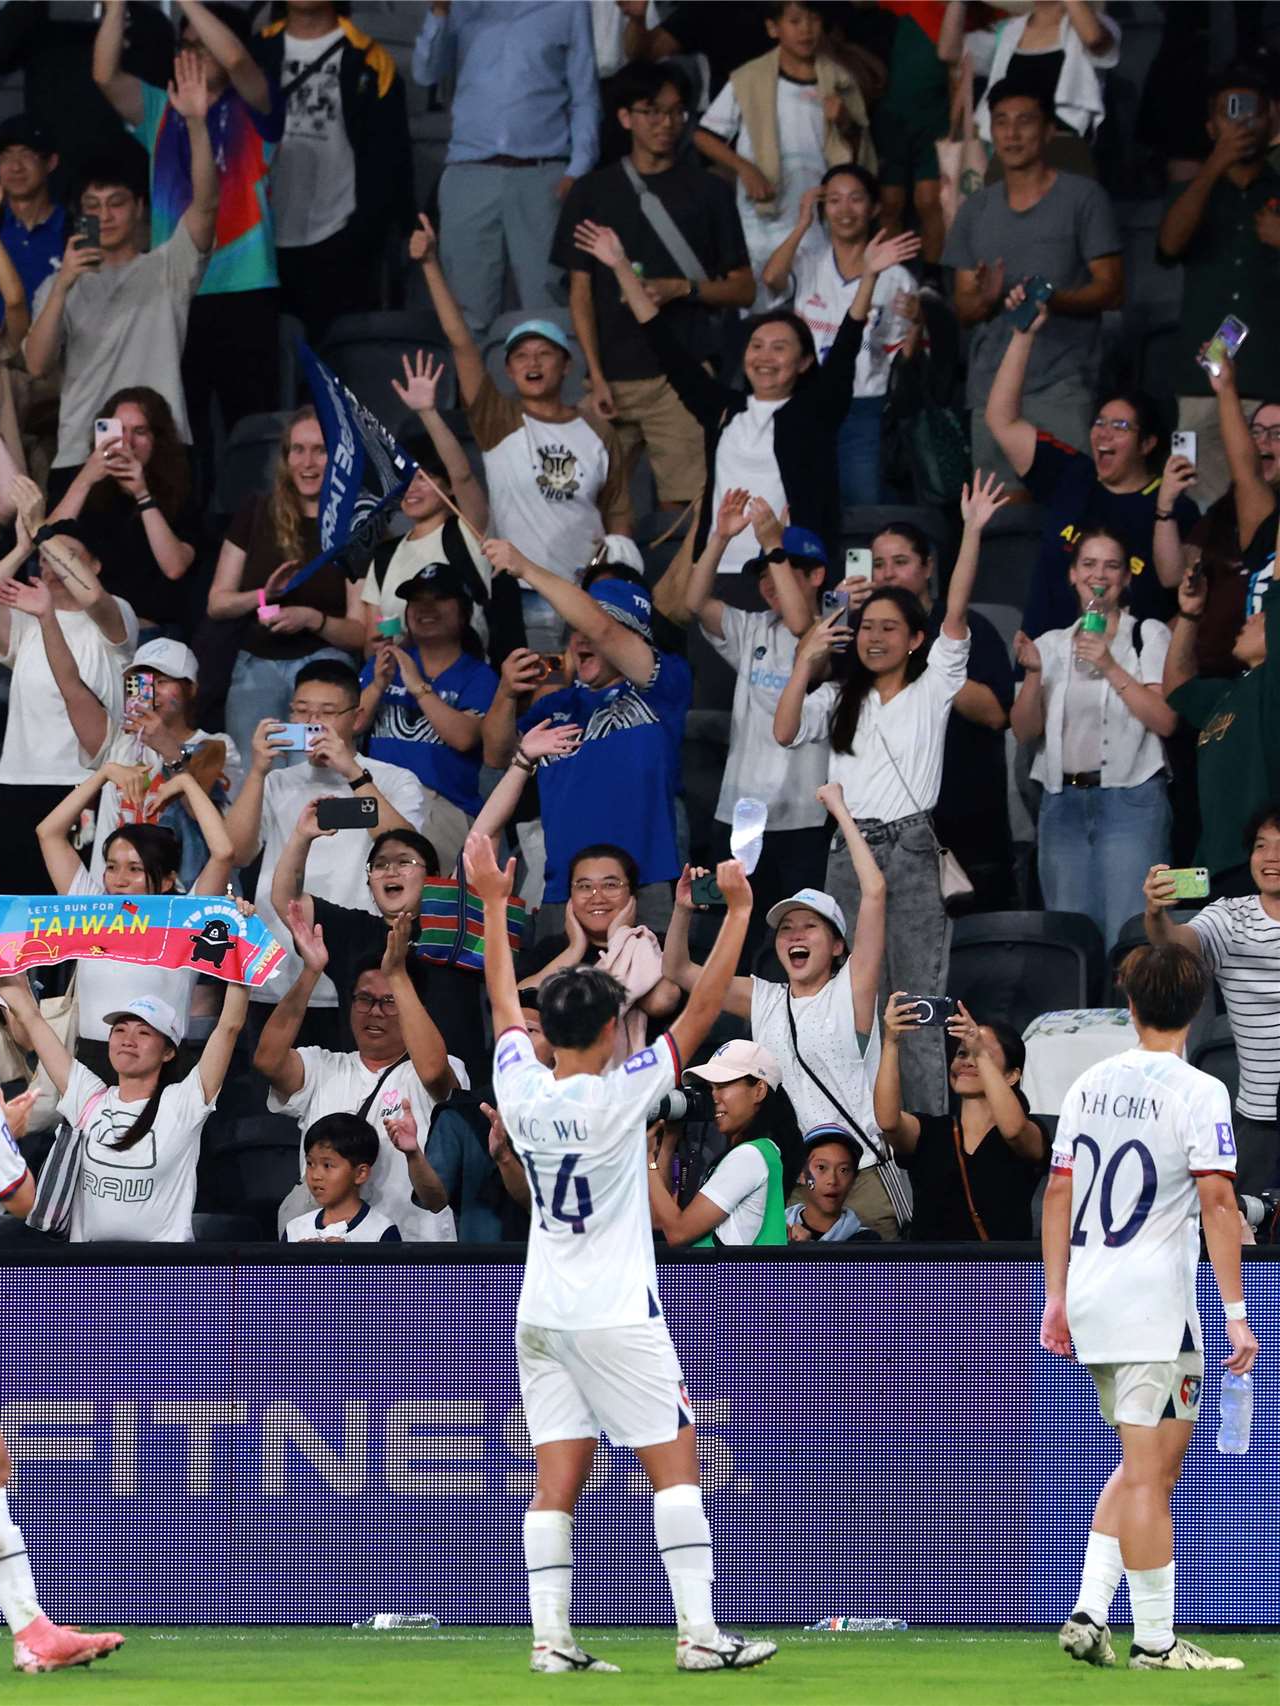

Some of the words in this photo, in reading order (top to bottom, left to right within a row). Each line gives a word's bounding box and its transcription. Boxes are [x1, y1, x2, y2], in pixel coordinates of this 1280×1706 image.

[28, 904, 60, 915] LET'S
[64, 903, 88, 912] RUN
[93, 903, 114, 911] FOR
[30, 914, 150, 938] TAIWAN
[1113, 1094, 1164, 1121] CHEN
[553, 1119, 588, 1142] WU
[82, 1169, 154, 1203] RAW
[523, 1150, 594, 1234] 14
[1070, 1133, 1158, 1248] 20
